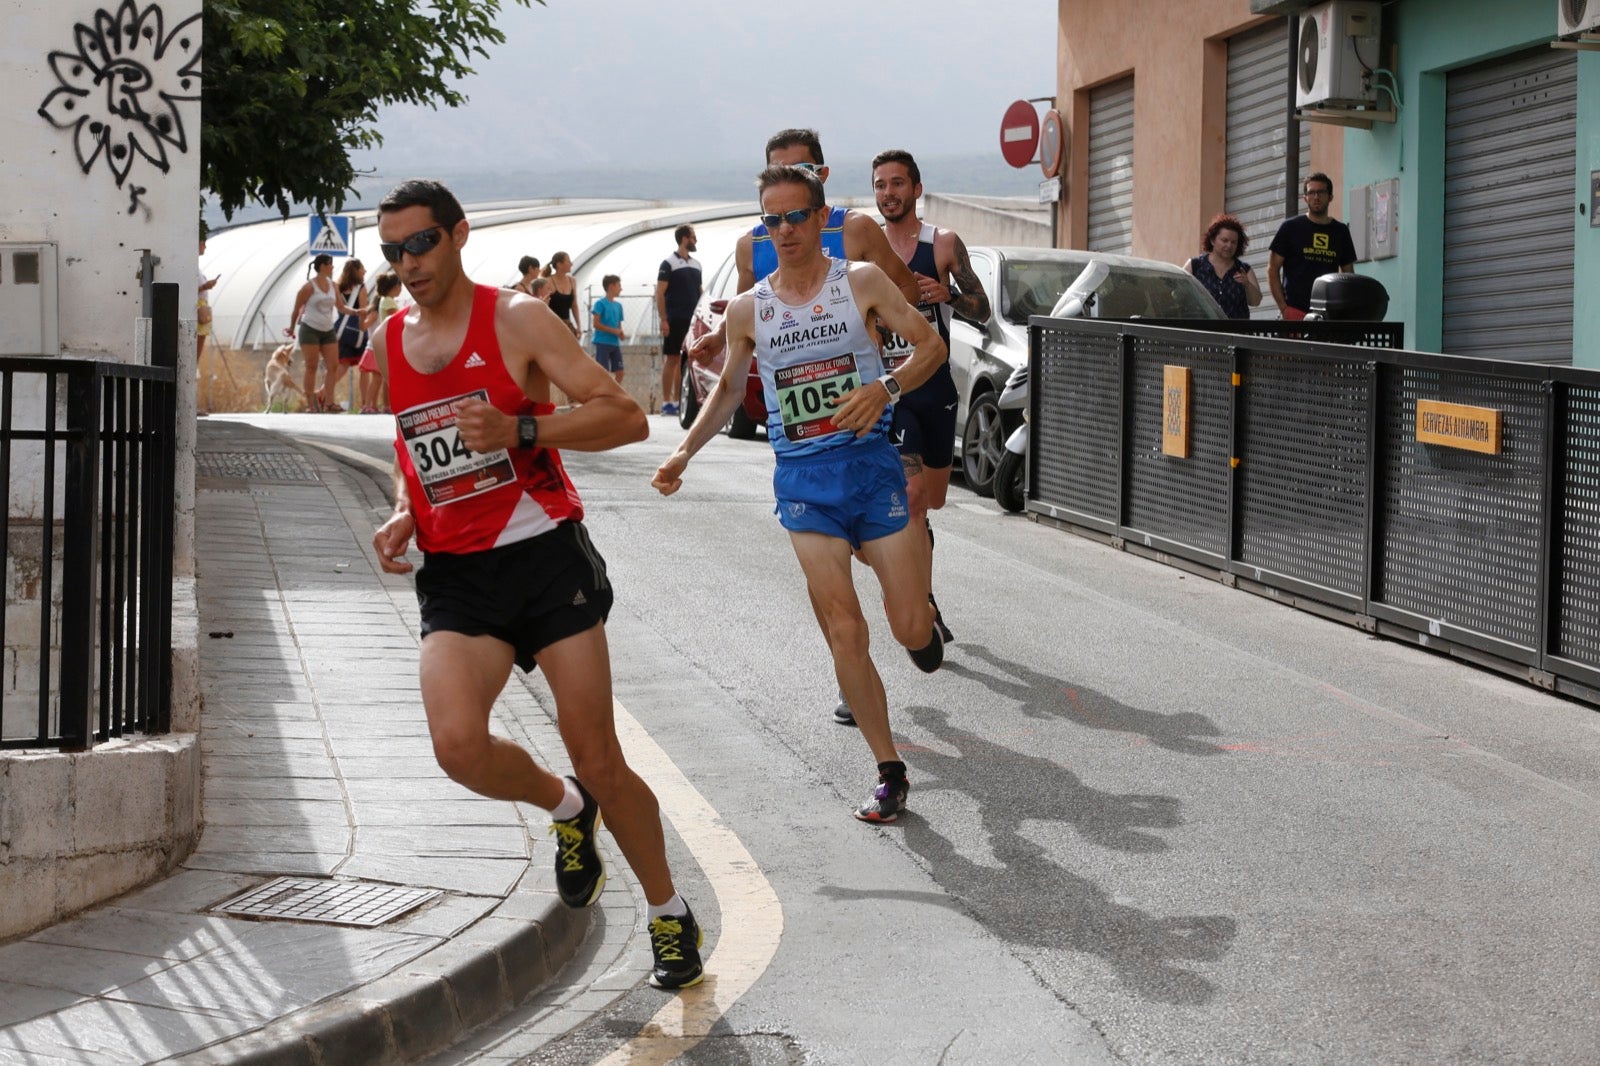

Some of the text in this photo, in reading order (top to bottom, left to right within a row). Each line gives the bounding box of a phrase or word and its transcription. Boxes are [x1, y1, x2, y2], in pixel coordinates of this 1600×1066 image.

[770, 321, 848, 349] MARACENA
[780, 344, 796, 353] CLUB
[806, 337, 840, 348] ATLETISMO
[791, 367, 805, 378] GRAN
[804, 363, 825, 375] PREMIO
[825, 361, 832, 370] DE
[832, 356, 850, 368] FONDO
[784, 376, 855, 417] 1051
[1422, 411, 1489, 443] CERVEZAS ALHAMBRA
[414, 430, 483, 473] 304
